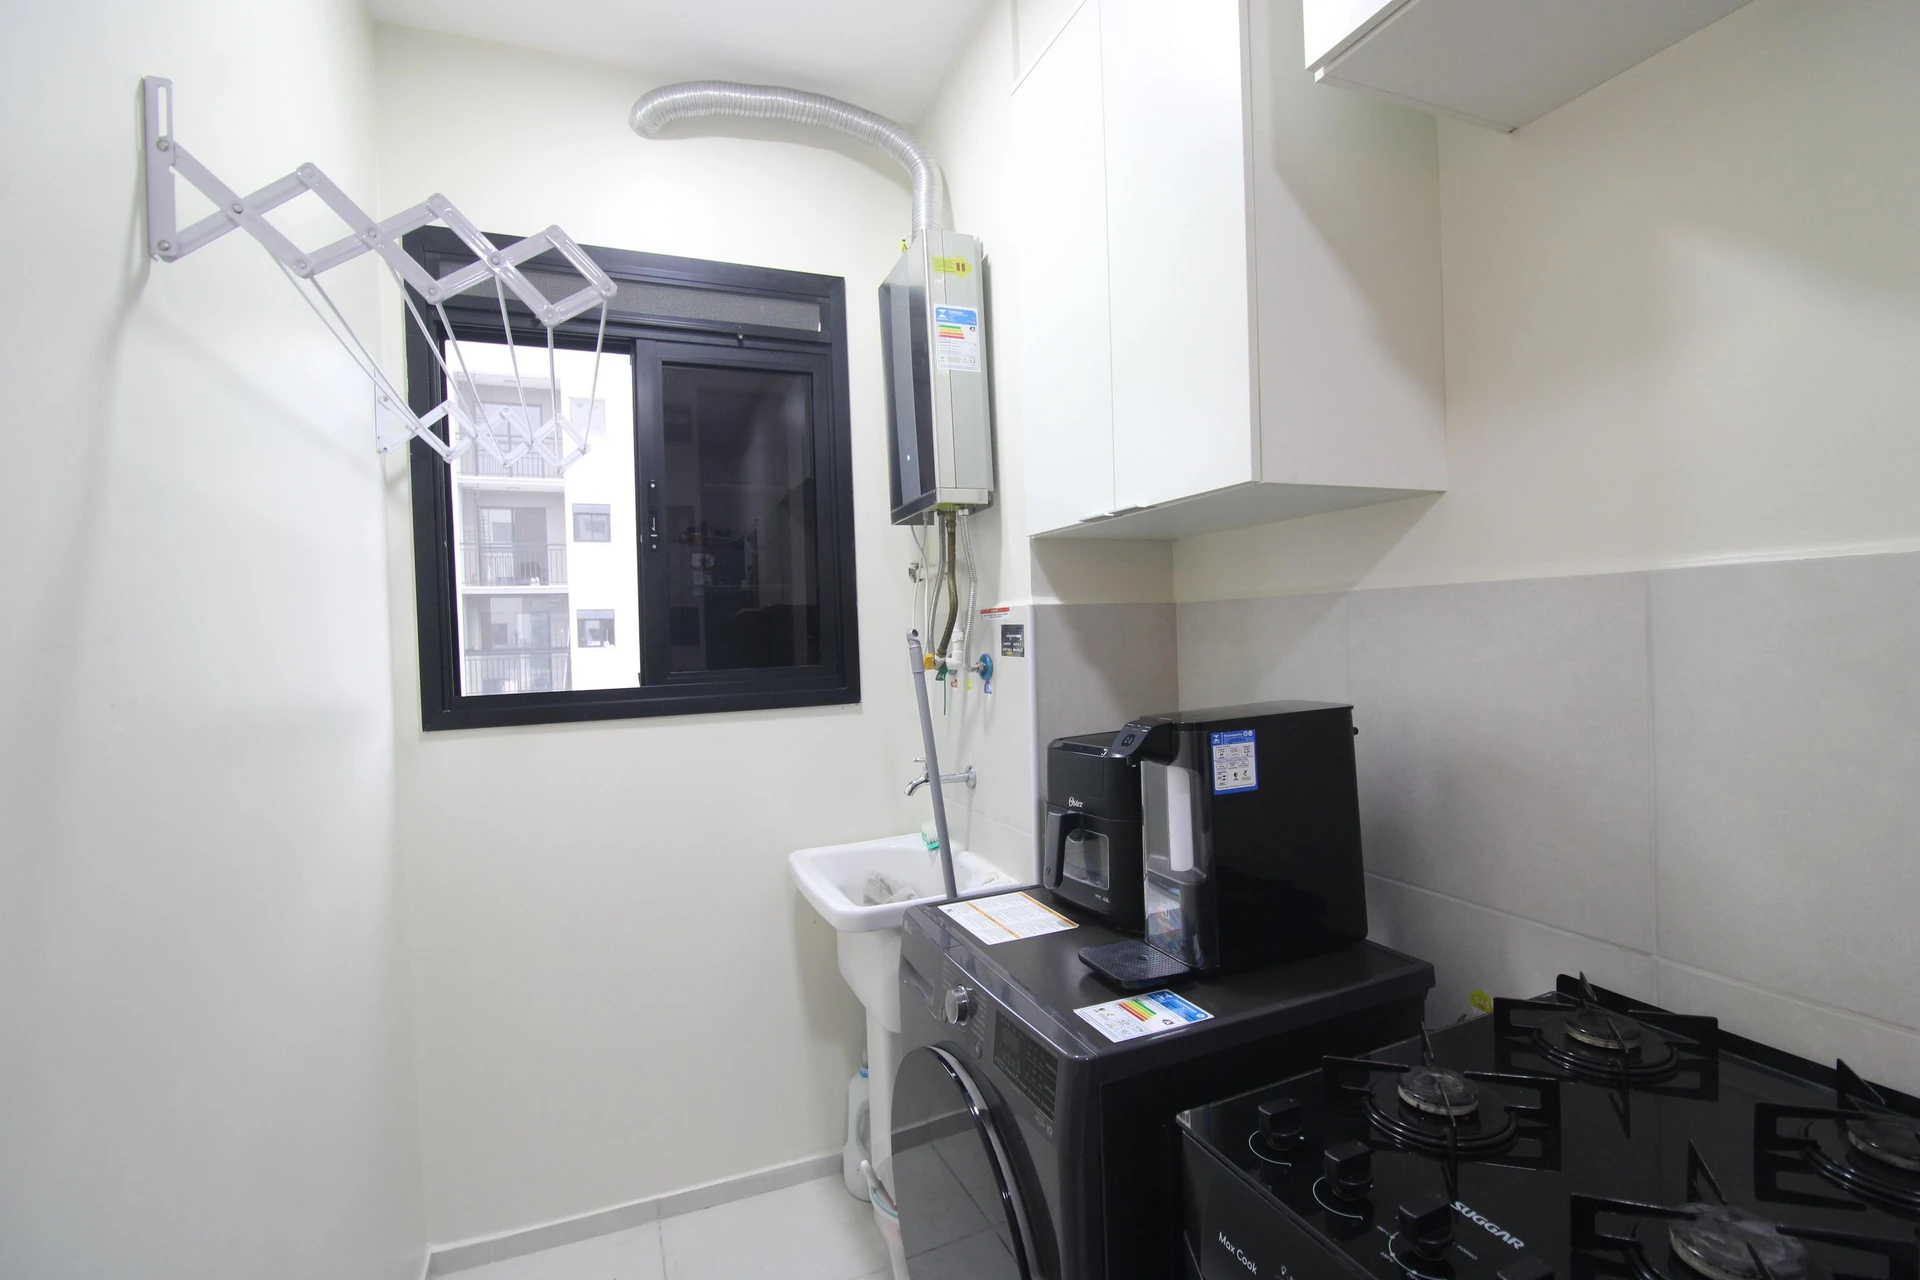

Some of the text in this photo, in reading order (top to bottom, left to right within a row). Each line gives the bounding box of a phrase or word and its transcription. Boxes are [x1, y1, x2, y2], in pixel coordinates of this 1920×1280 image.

[1068, 796, 1083, 808] Oster
[1450, 1201, 1525, 1250] SUGGAR
[1218, 1231, 1258, 1276] Max Cook
